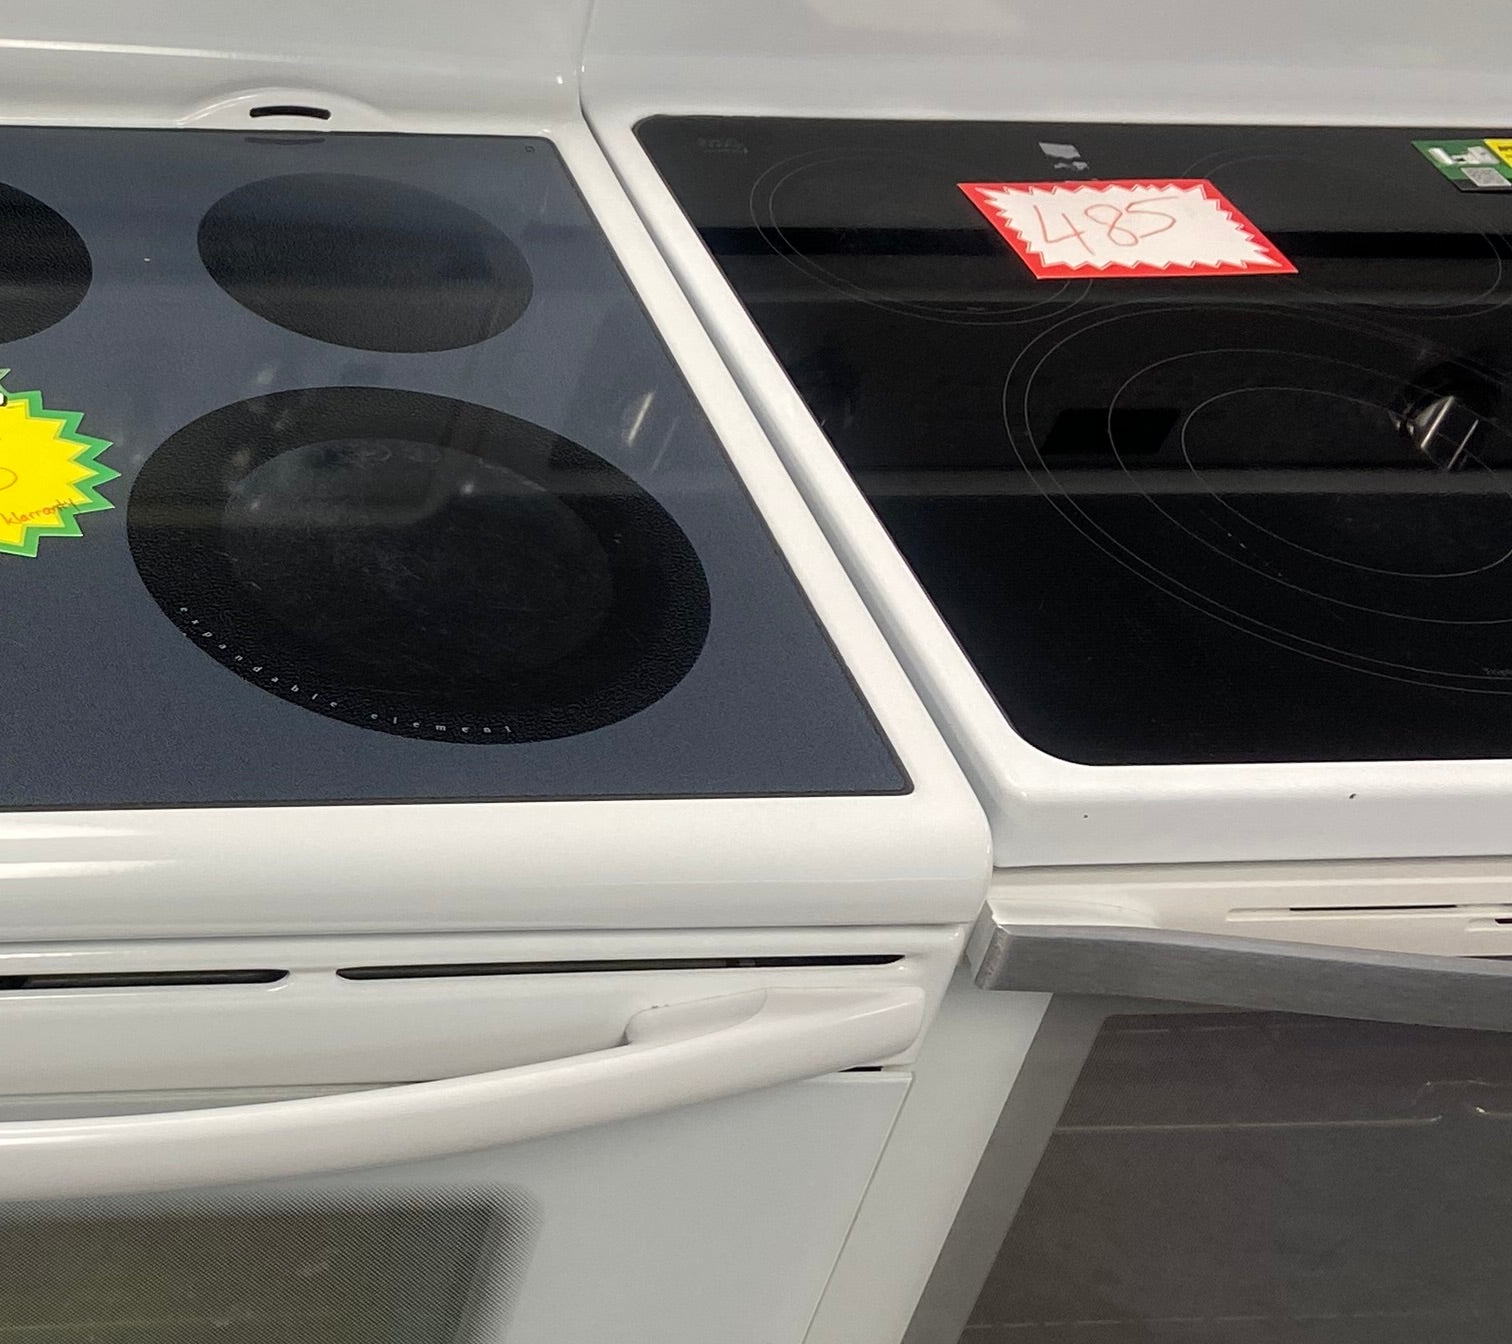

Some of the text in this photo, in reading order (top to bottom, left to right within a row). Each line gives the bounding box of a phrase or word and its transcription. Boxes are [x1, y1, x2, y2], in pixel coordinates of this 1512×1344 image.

[1033, 196, 1180, 256] 485
[180, 606, 512, 734] expandable element
